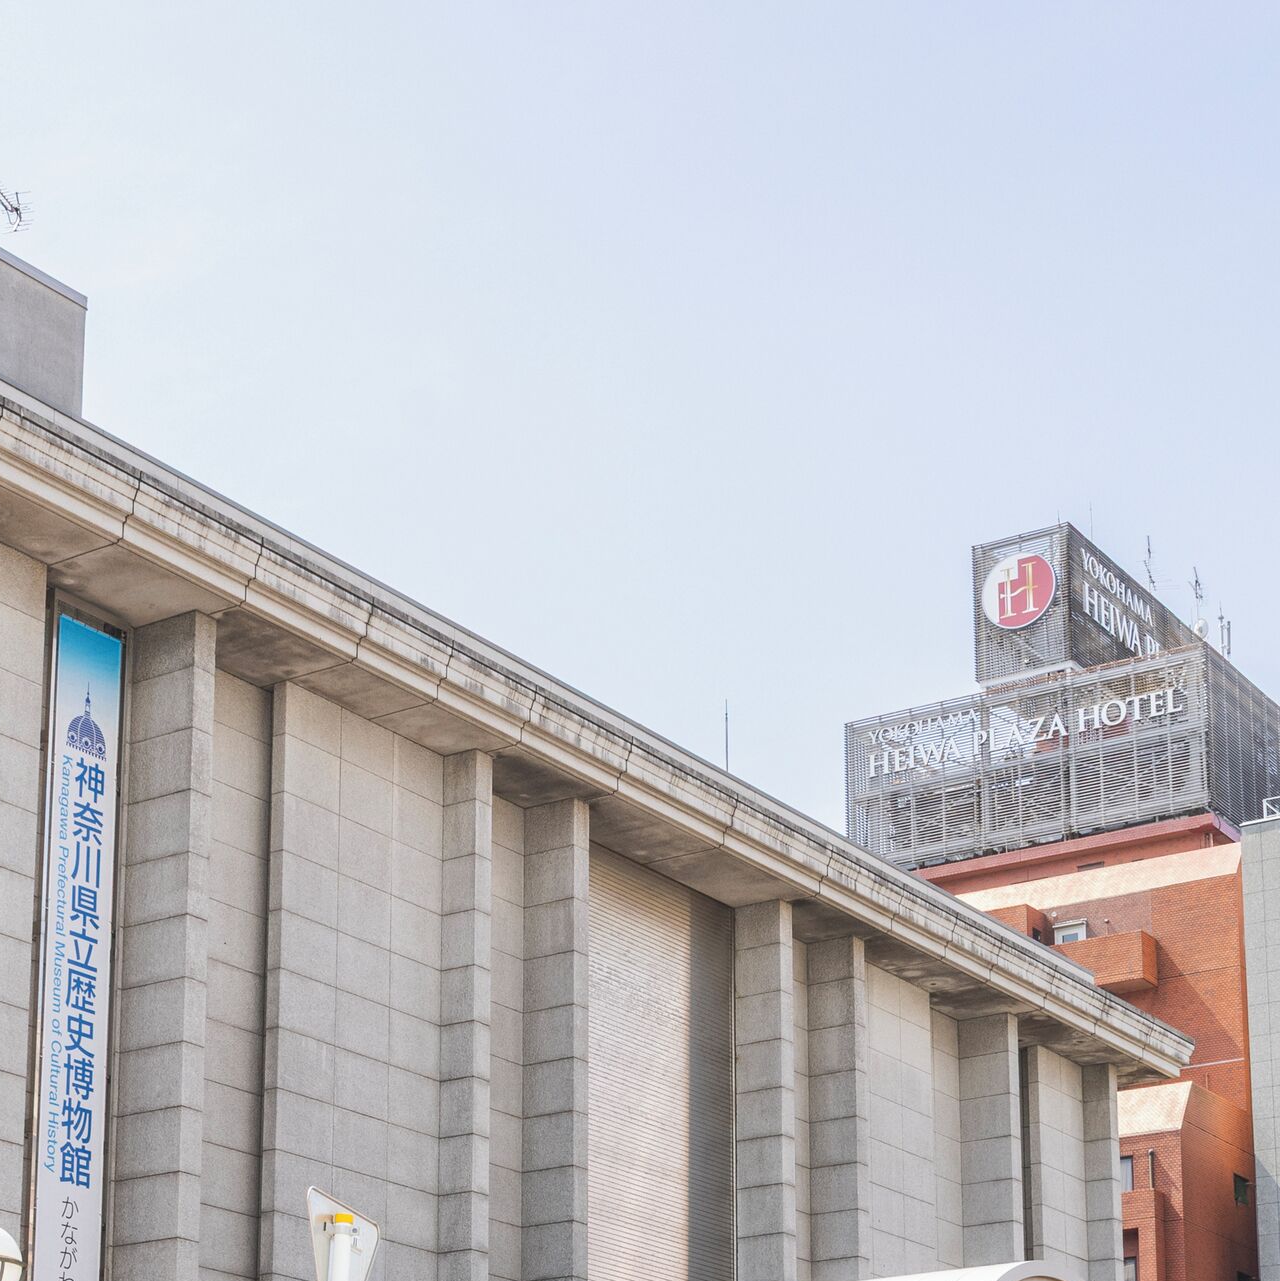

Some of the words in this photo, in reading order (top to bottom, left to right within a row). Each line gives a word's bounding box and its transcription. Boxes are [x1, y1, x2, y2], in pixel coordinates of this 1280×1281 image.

[999, 561, 1040, 619] H
[1080, 547, 1154, 627] YOKOHAMA
[1082, 580, 1143, 658] HEIWA
[868, 708, 979, 745] YOKOHAMA
[868, 738, 962, 778] HEIWA
[973, 712, 1069, 756] PLAZA
[1077, 688, 1184, 733] HOTEL
[58, 754, 73, 842] Kanagawa
[55, 845, 70, 938] Prefectural
[51, 941, 66, 1014] Museum
[59, 756, 106, 1190] 神奈川県立歴史博物館
[52, 1017, 63, 1037] of
[48, 1040, 63, 1109] Cultural
[43, 1111, 60, 1174] History
